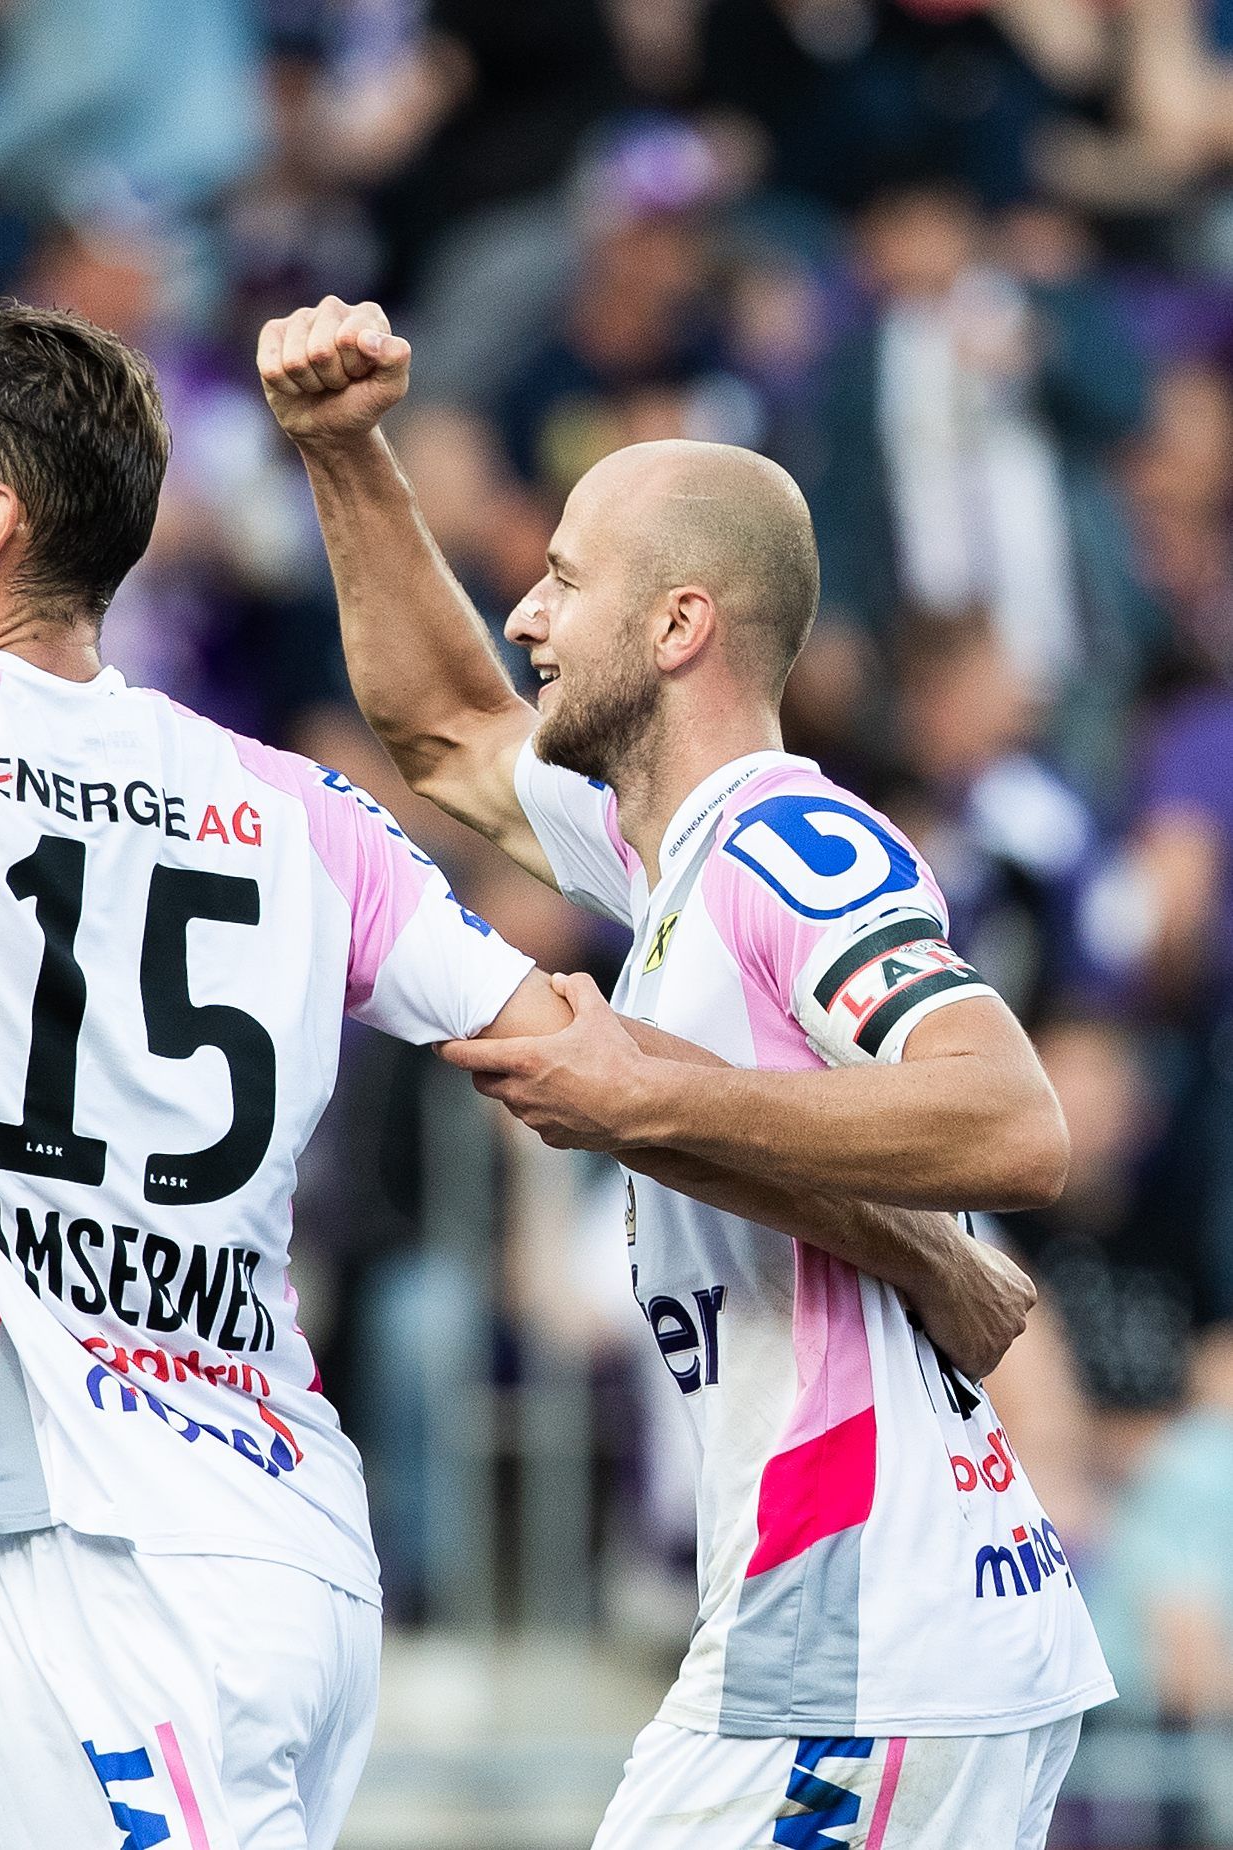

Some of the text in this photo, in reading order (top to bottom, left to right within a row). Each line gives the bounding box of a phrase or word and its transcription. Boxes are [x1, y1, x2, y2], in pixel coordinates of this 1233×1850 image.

[668, 810, 708, 858] GEMEINSAM
[26, 1141, 63, 1157] LASK
[149, 1173, 188, 1189] LASK
